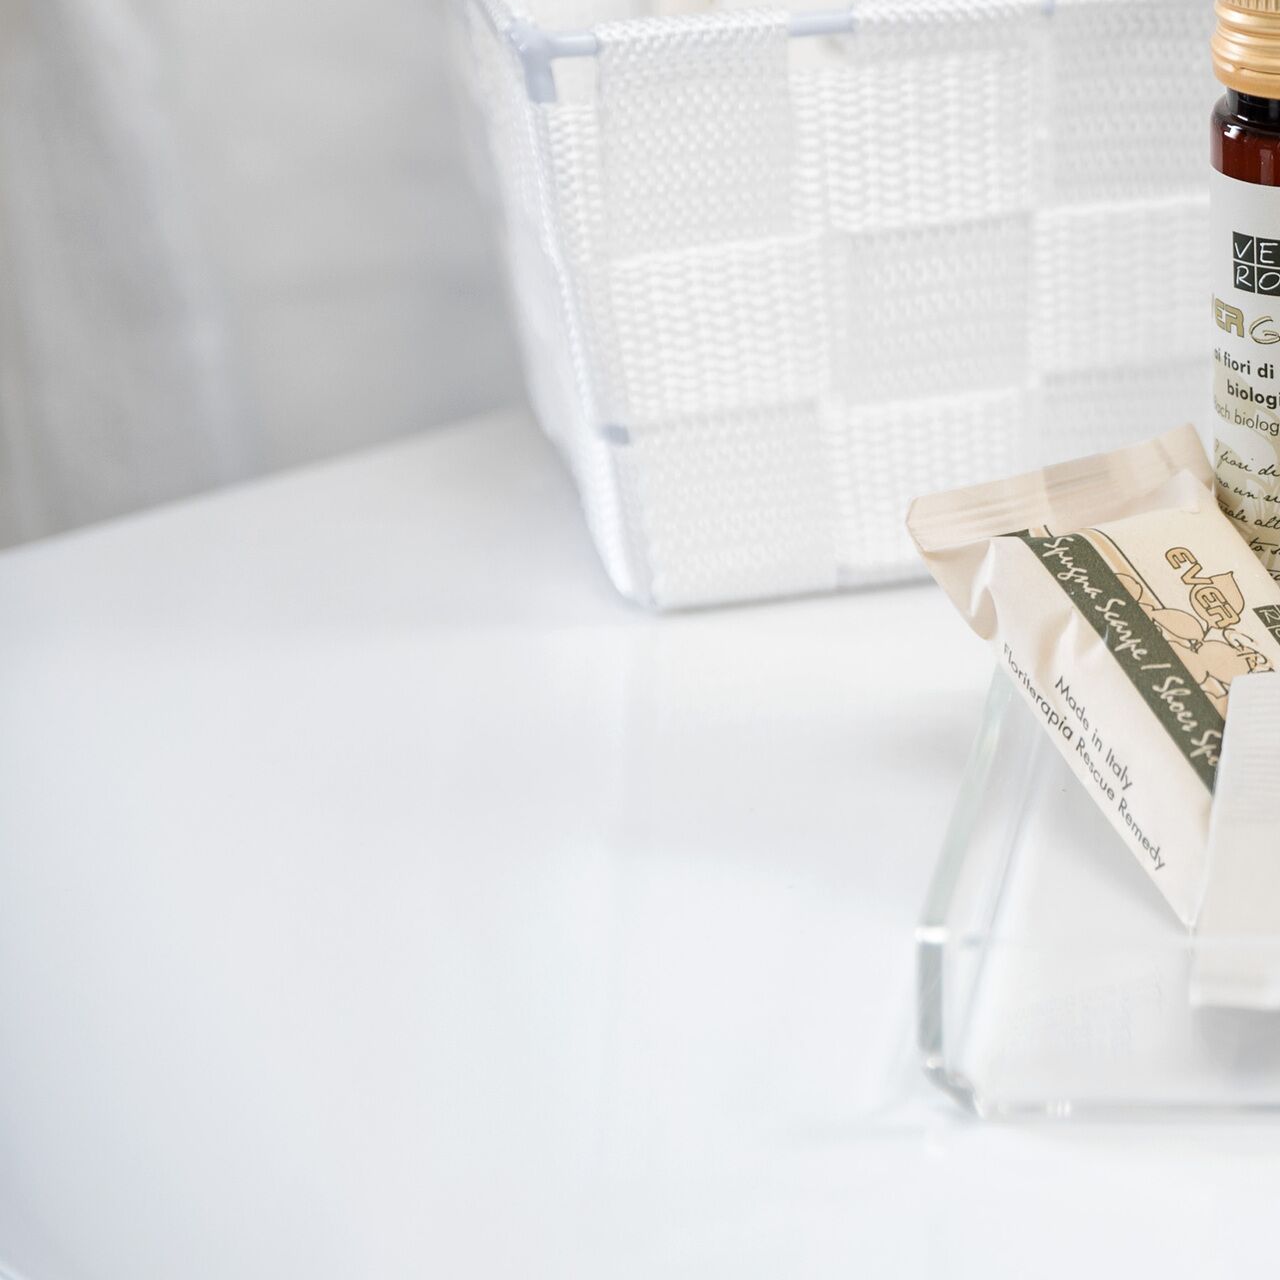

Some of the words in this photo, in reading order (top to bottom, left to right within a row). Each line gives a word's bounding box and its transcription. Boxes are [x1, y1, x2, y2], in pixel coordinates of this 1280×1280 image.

[1223, 351, 1251, 375] fiori
[1257, 363, 1275, 380] di
[1165, 546, 1242, 630] EVER
[1094, 597, 1149, 661] Scarpe
[1151, 674, 1200, 733] Shoes
[1003, 642, 1074, 742] Floriterapia
[1075, 736, 1115, 801] Rescue
[1117, 796, 1166, 871] Remedy
[1054, 675, 1090, 732] Made
[1091, 730, 1103, 753] in
[1105, 747, 1133, 791] Italy
